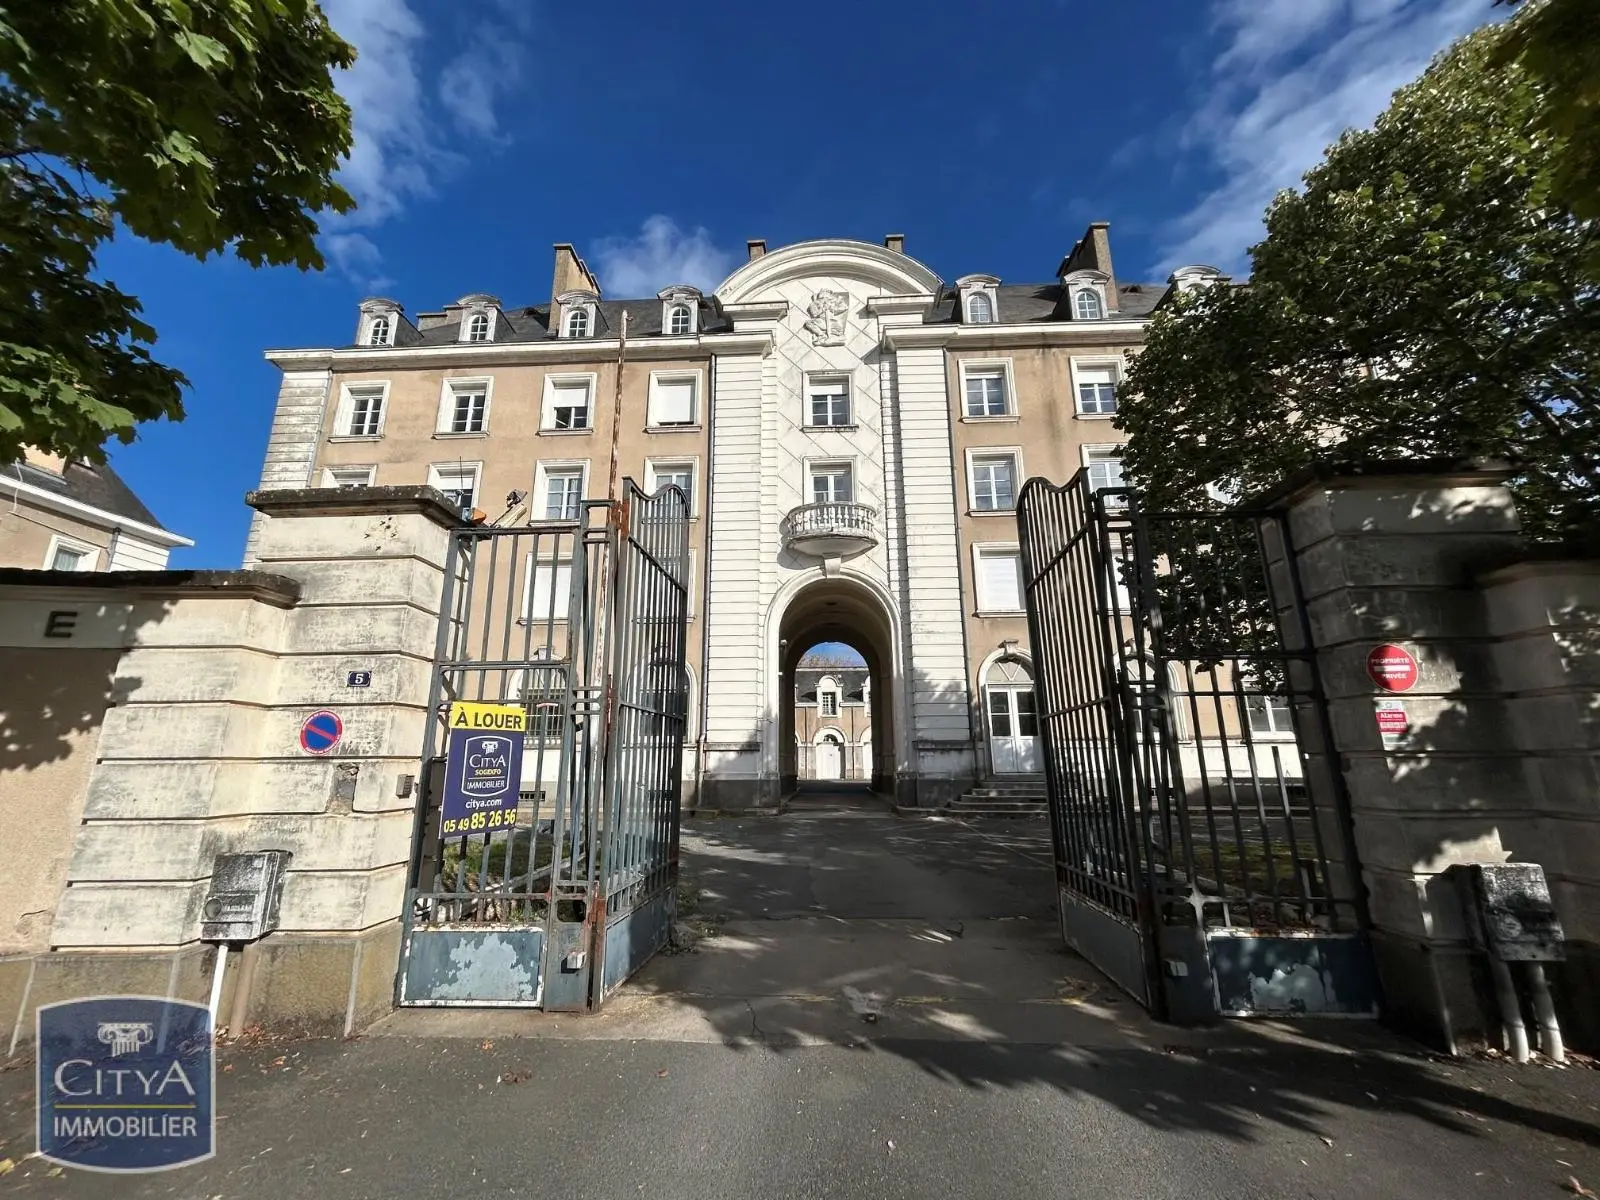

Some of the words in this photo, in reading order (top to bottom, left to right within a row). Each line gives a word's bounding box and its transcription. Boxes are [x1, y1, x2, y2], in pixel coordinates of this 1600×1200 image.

[44, 610, 79, 638] E
[355, 673, 364, 684] 5
[455, 707, 469, 727] À
[473, 711, 522, 729] LOUER
[469, 754, 506, 768] CITYA
[467, 780, 505, 790] IMMOBILIER
[465, 798, 502, 809] citya.com
[443, 819, 456, 833] 05
[457, 817, 470, 831] 49
[470, 812, 486, 830] 85
[487, 810, 503, 827] 26
[503, 808, 517, 825] 56
